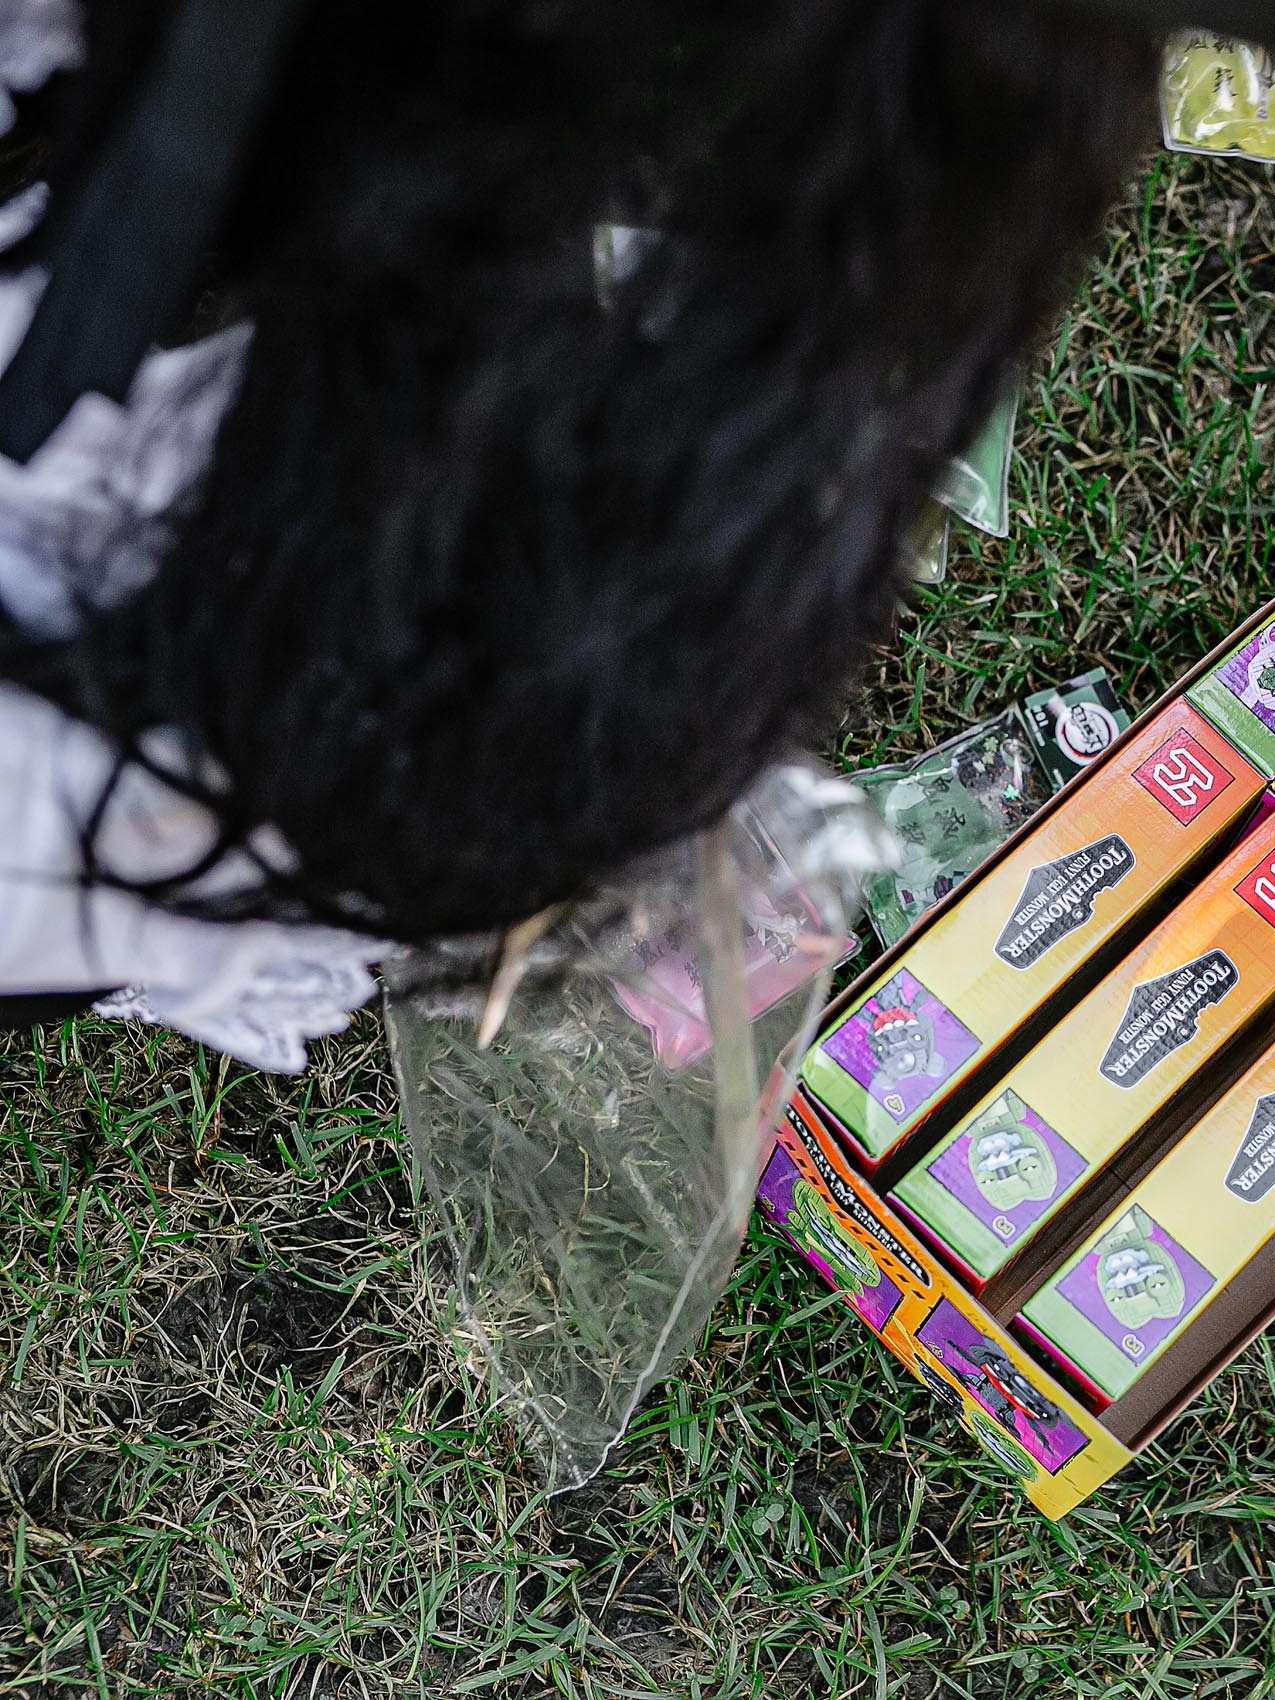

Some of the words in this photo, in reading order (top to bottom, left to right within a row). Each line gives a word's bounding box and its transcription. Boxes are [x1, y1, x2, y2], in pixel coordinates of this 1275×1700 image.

[1064, 853, 1092, 879] FUNNY
[1047, 875, 1068, 896] UGLY
[1014, 892, 1050, 926] MONSTER
[1169, 969, 1195, 996] FUNNY
[1151, 992, 1172, 1014] UGLY
[1118, 1009, 1154, 1044] MONSTER
